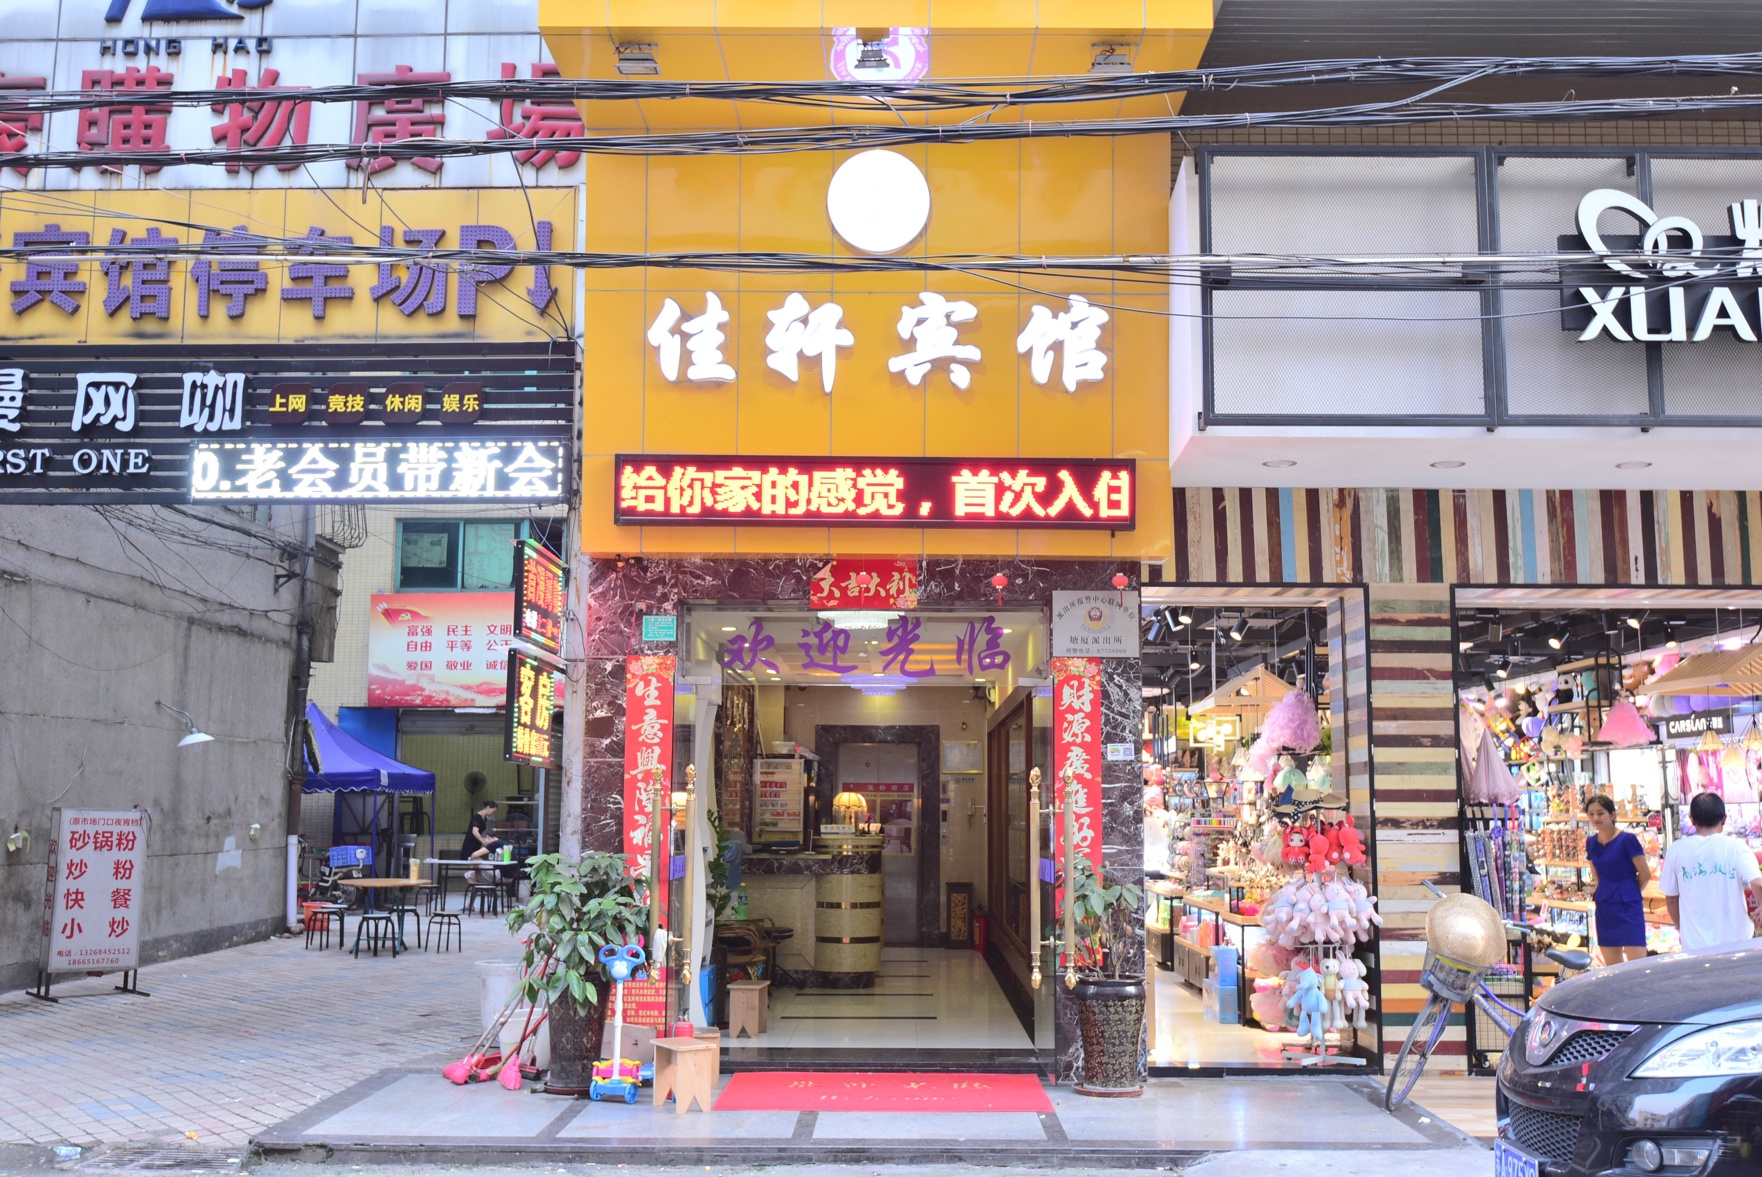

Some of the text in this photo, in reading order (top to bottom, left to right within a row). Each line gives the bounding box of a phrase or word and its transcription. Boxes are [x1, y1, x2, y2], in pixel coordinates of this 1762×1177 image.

[100, 36, 273, 56] HONG HAO
[1577, 286, 1762, 342] XUA
[647, 291, 1110, 394] 佳轩宾馆
[269, 394, 480, 412] 上网 竞技 休闲 娱乐
[0, 448, 150, 475] ST ONE
[816, 571, 911, 598] 大吉大利
[407, 624, 433, 637] 富强
[446, 624, 473, 637] 民主
[486, 624, 512, 637] 文明
[1069, 635, 1122, 645] 塘厦派出所
[406, 640, 433, 652] 自由
[446, 640, 473, 652] 平等
[722, 616, 1011, 678] 欢迎光临
[406, 660, 508, 671] 爱国 敬业 诚信
[69, 830, 137, 851] 砂锅粉
[66, 859, 134, 880] 炒粉
[64, 888, 131, 910] 快餐
[61, 917, 129, 939] 小炒
